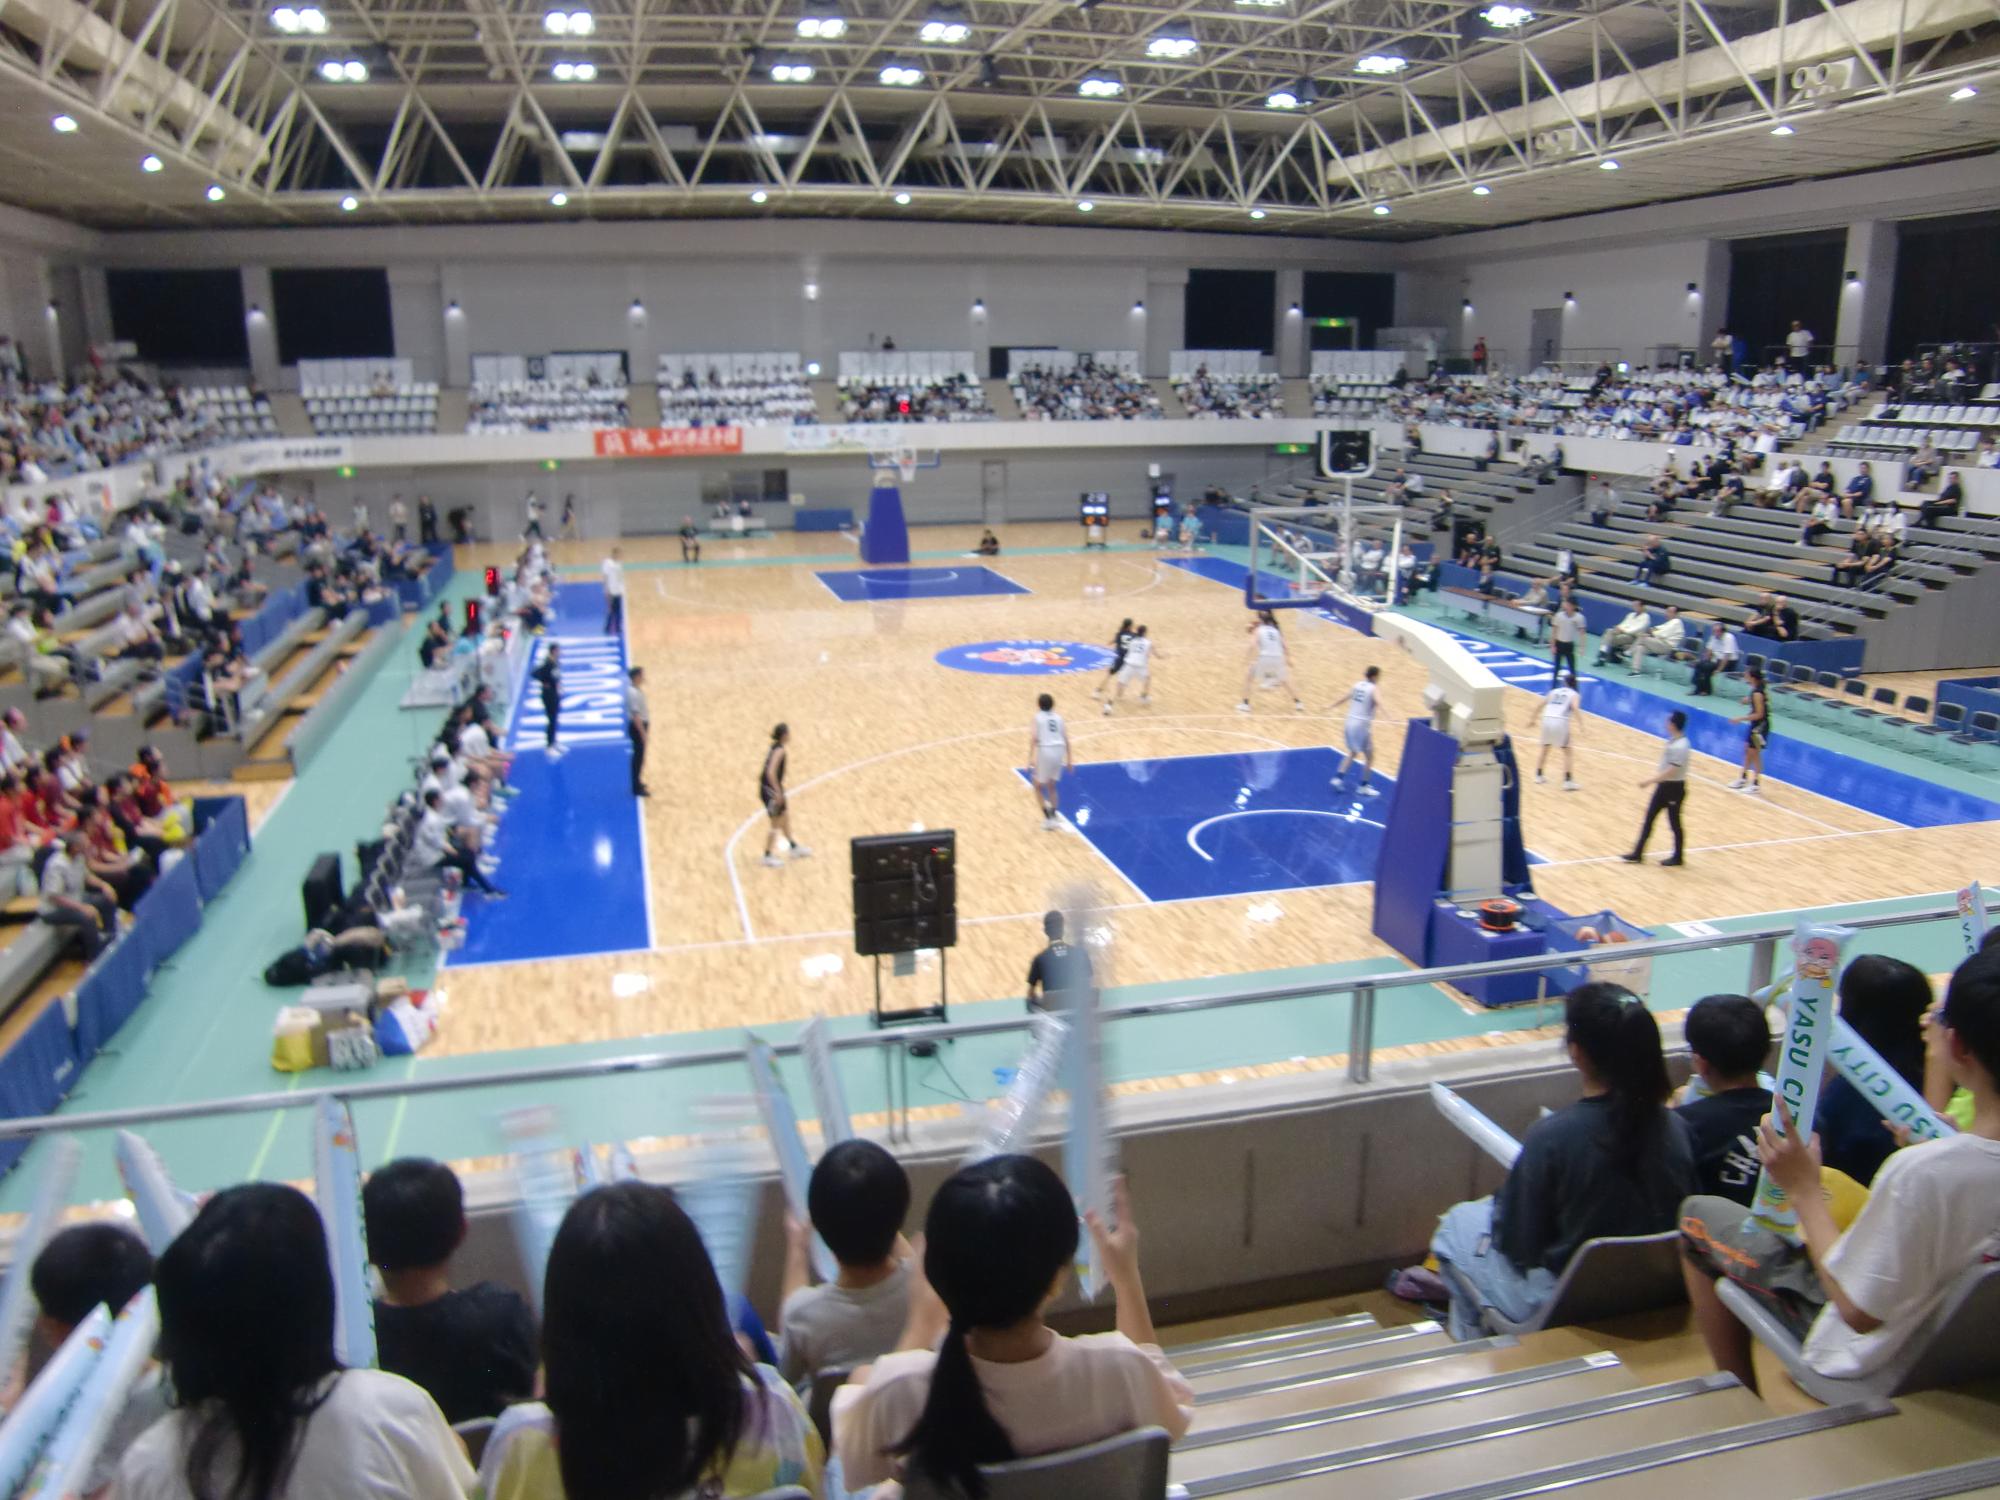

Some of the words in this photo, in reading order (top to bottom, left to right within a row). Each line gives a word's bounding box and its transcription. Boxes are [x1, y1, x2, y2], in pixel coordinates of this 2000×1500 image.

[1788, 998, 1819, 1069] YASU
[1831, 1046, 1893, 1097] CITY
[1776, 1077, 1804, 1138] CIT
